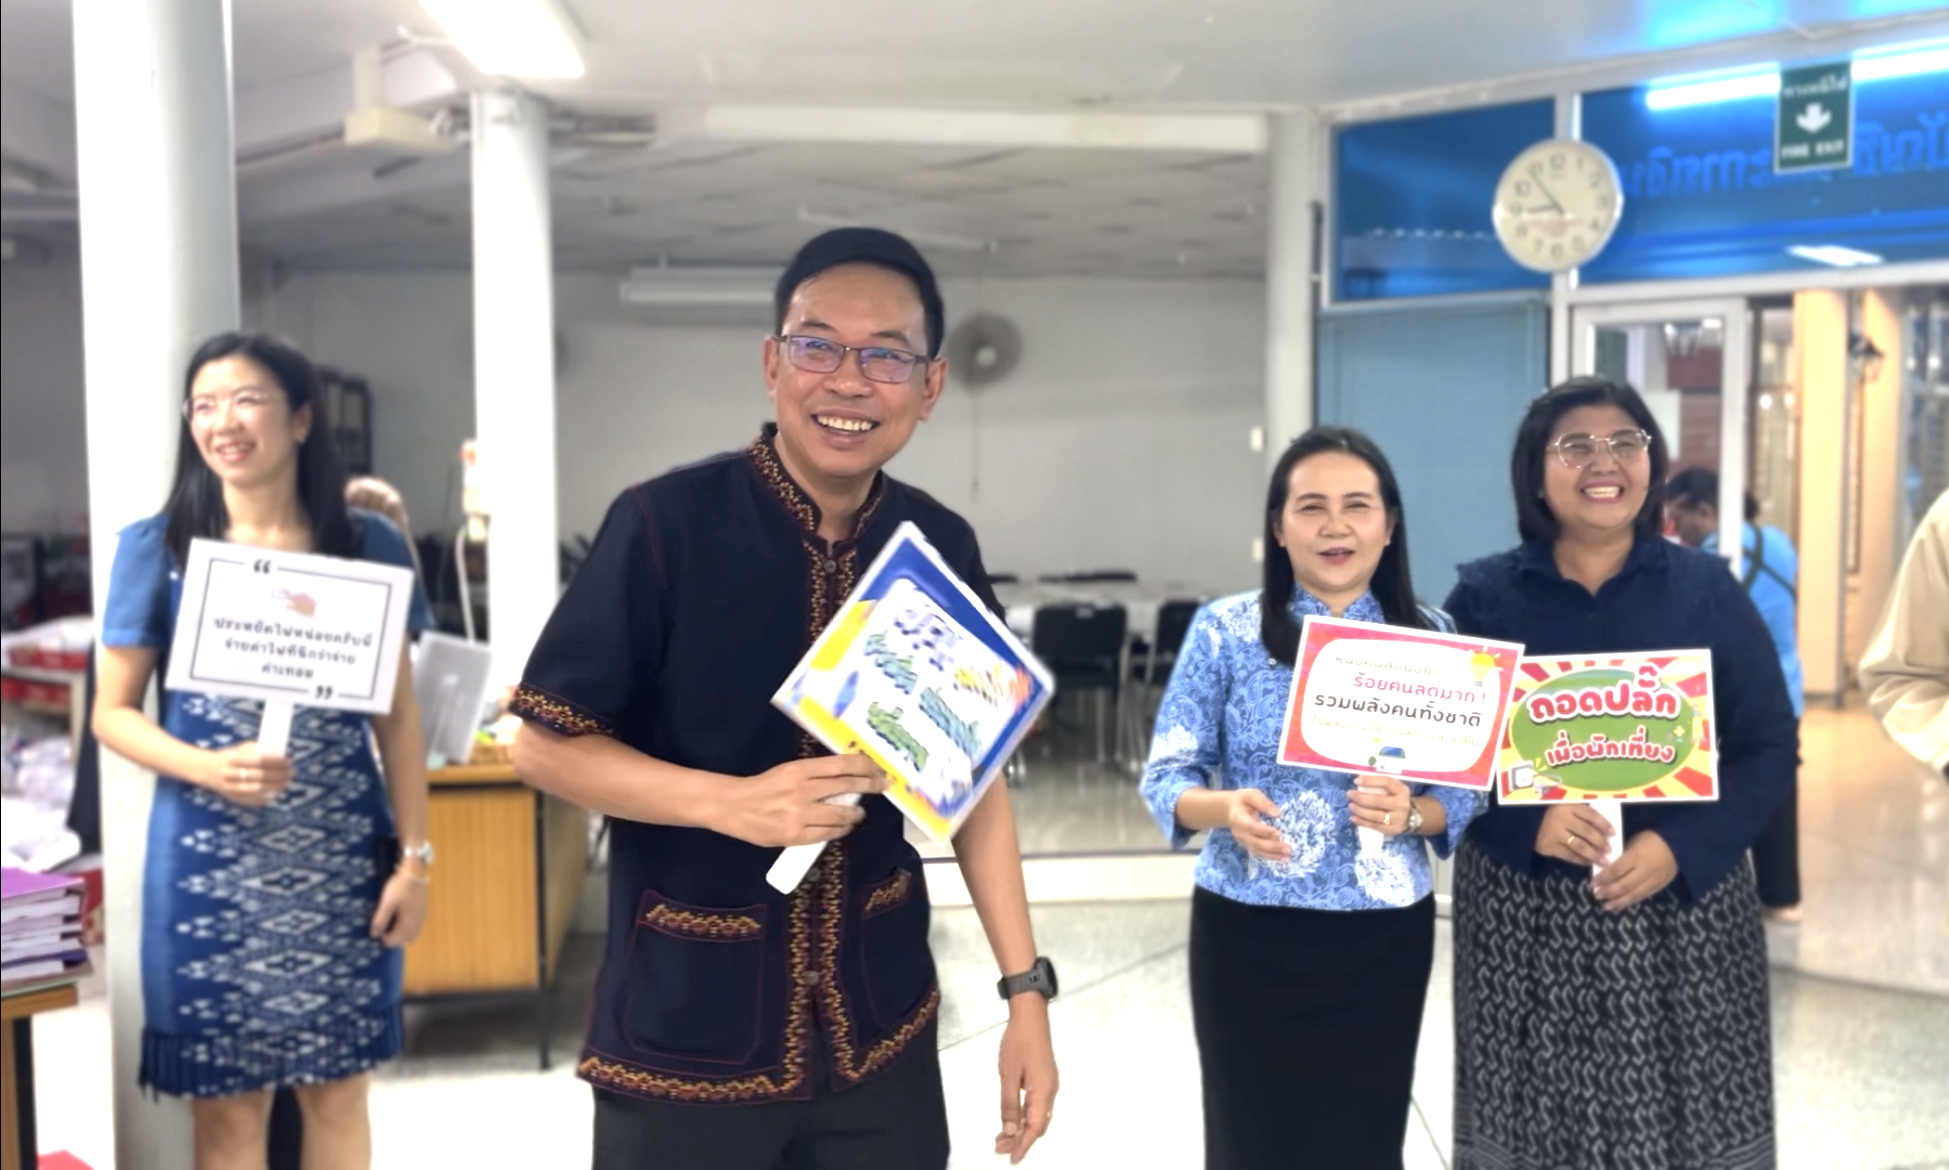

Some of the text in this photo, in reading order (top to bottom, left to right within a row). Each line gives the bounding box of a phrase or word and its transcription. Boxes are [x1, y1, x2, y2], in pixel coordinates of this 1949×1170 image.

[1314, 693, 1482, 727] รวมพลังคนทั้งชาติ
[1530, 665, 1678, 719] ถอดปลั๊ก
[1546, 726, 1675, 766] เมื่อพักเที่ยง
